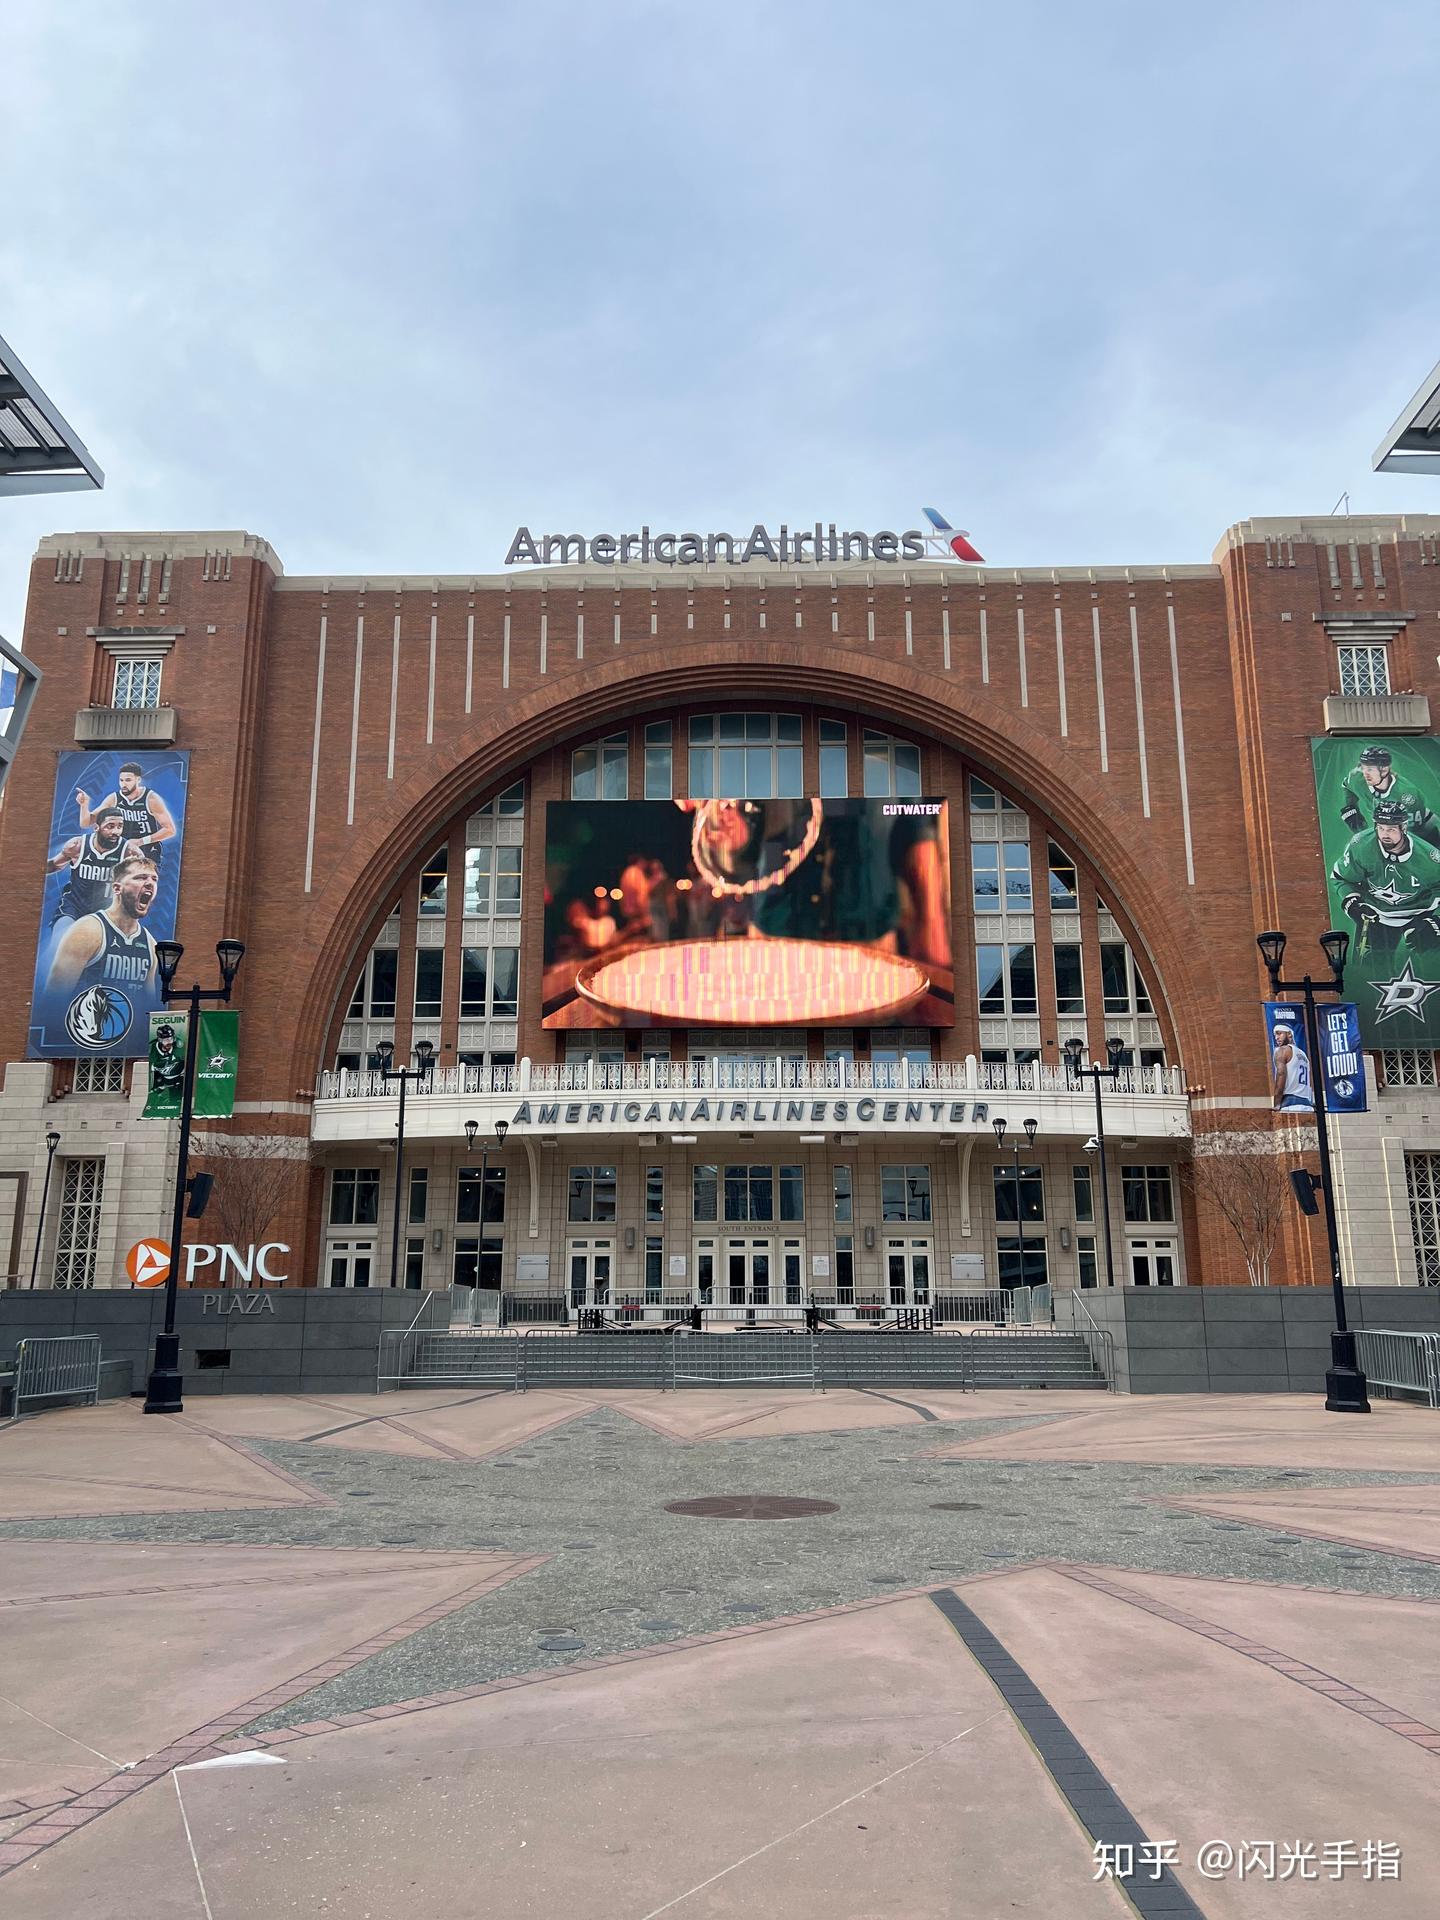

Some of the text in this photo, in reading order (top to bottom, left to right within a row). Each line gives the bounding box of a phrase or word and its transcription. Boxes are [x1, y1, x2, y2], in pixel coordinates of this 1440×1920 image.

[138, 821, 152, 834] 31
[79, 863, 112, 881] MAV
[103, 953, 149, 981] MAVS
[151, 1016, 186, 1025] SEGUIN
[1326, 1012, 1348, 1032] LET'S
[1330, 1030, 1349, 1054] GET
[1298, 1064, 1308, 1086] 21
[1326, 1052, 1358, 1078] LOUD!
[183, 1243, 291, 1282] PNC
[202, 1293, 275, 1315] PLAZA
